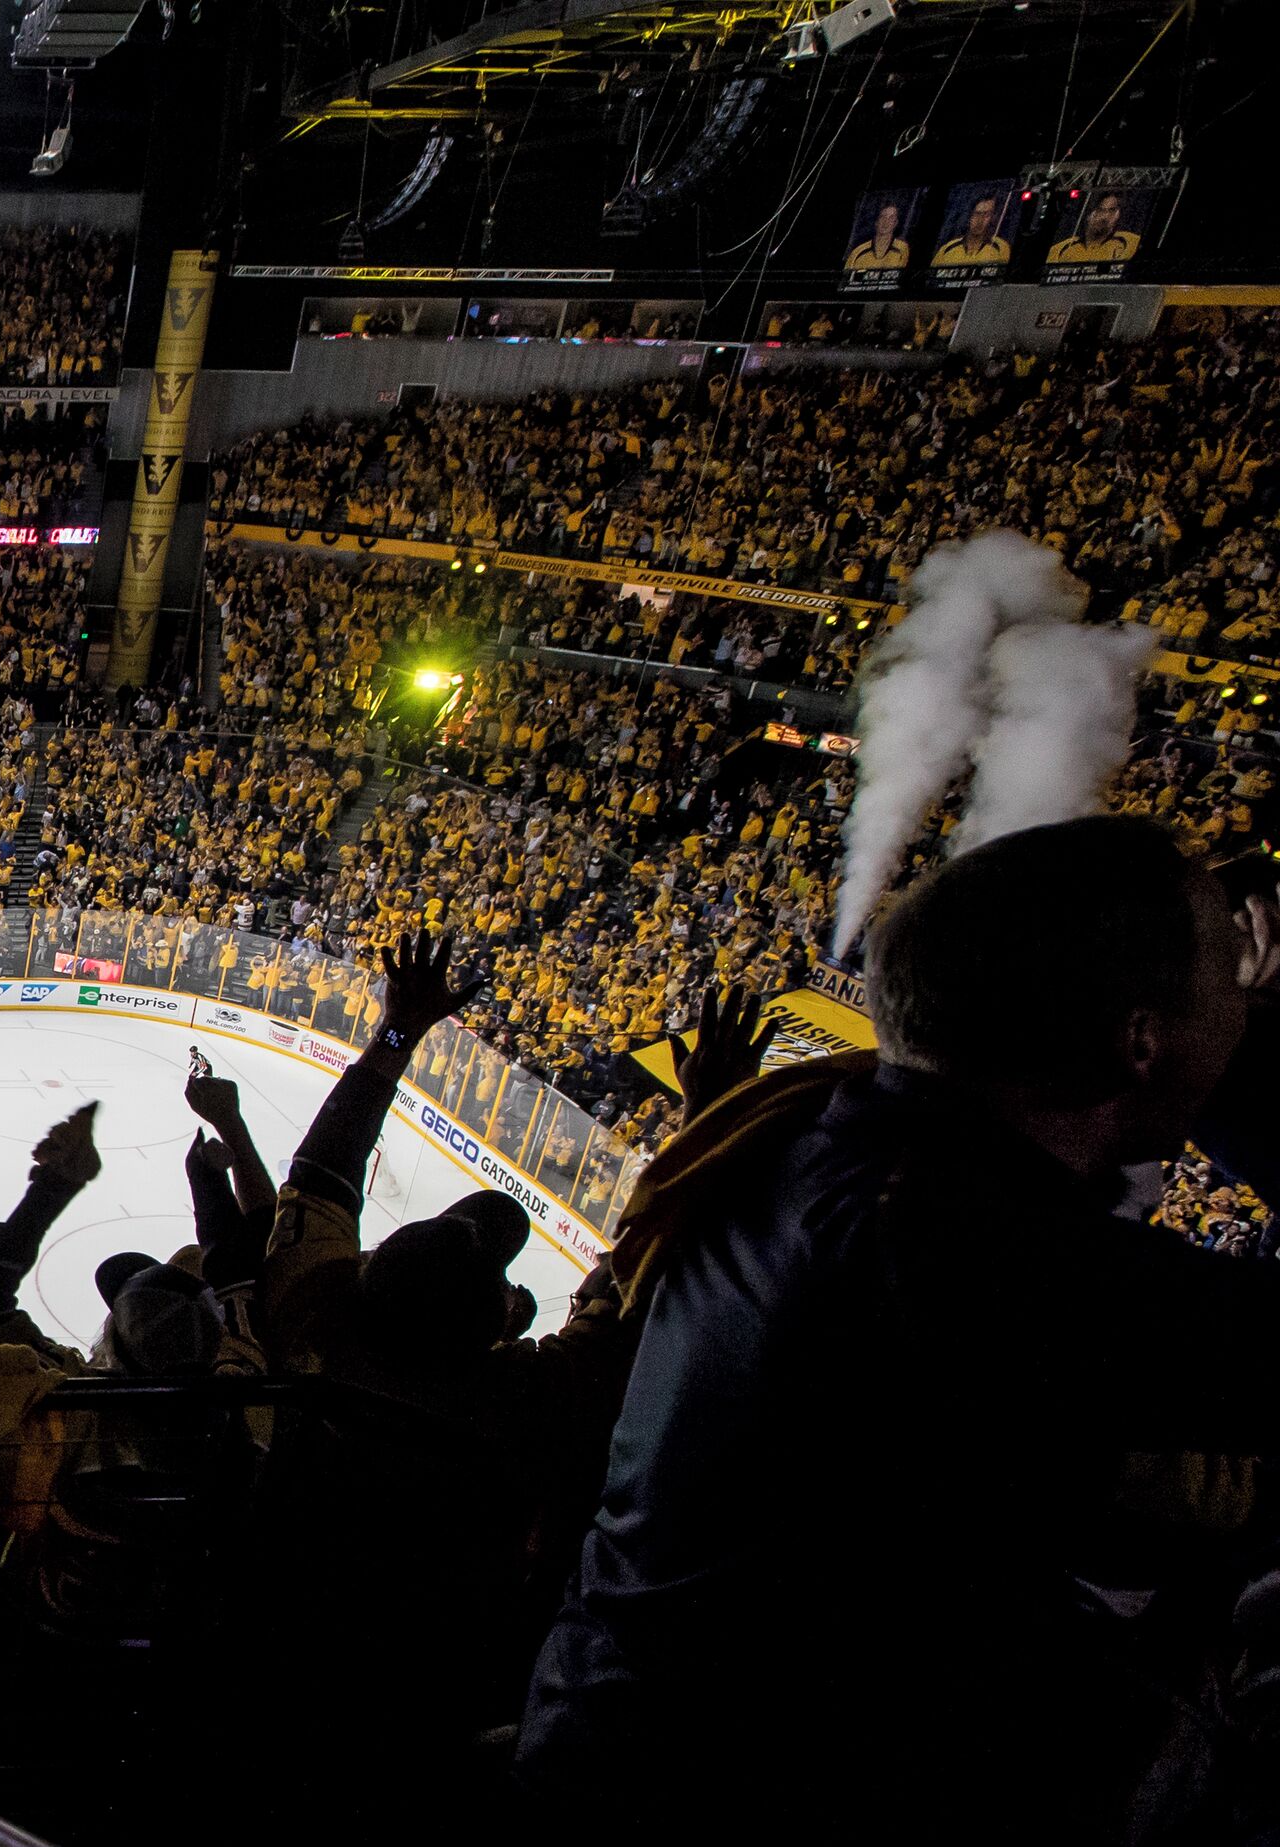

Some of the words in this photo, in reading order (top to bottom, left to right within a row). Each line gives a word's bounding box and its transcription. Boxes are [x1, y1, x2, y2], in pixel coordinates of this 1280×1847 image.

[60, 390, 113, 400] LEVEL
[637, 572, 734, 593] NASHVILLE
[737, 587, 838, 611] PREDATORS
[22, 986, 50, 1000] SAP
[813, 966, 866, 1008] BAND
[80, 989, 178, 1012] enterprise
[205, 1018, 246, 1033] NHL.com/100
[760, 1005, 861, 1052] SMASHV
[312, 1051, 347, 1071] DONUTS
[313, 1042, 351, 1063] DUNKIN'
[420, 1105, 480, 1164] GEICO
[480, 1156, 550, 1221] GATORADE
